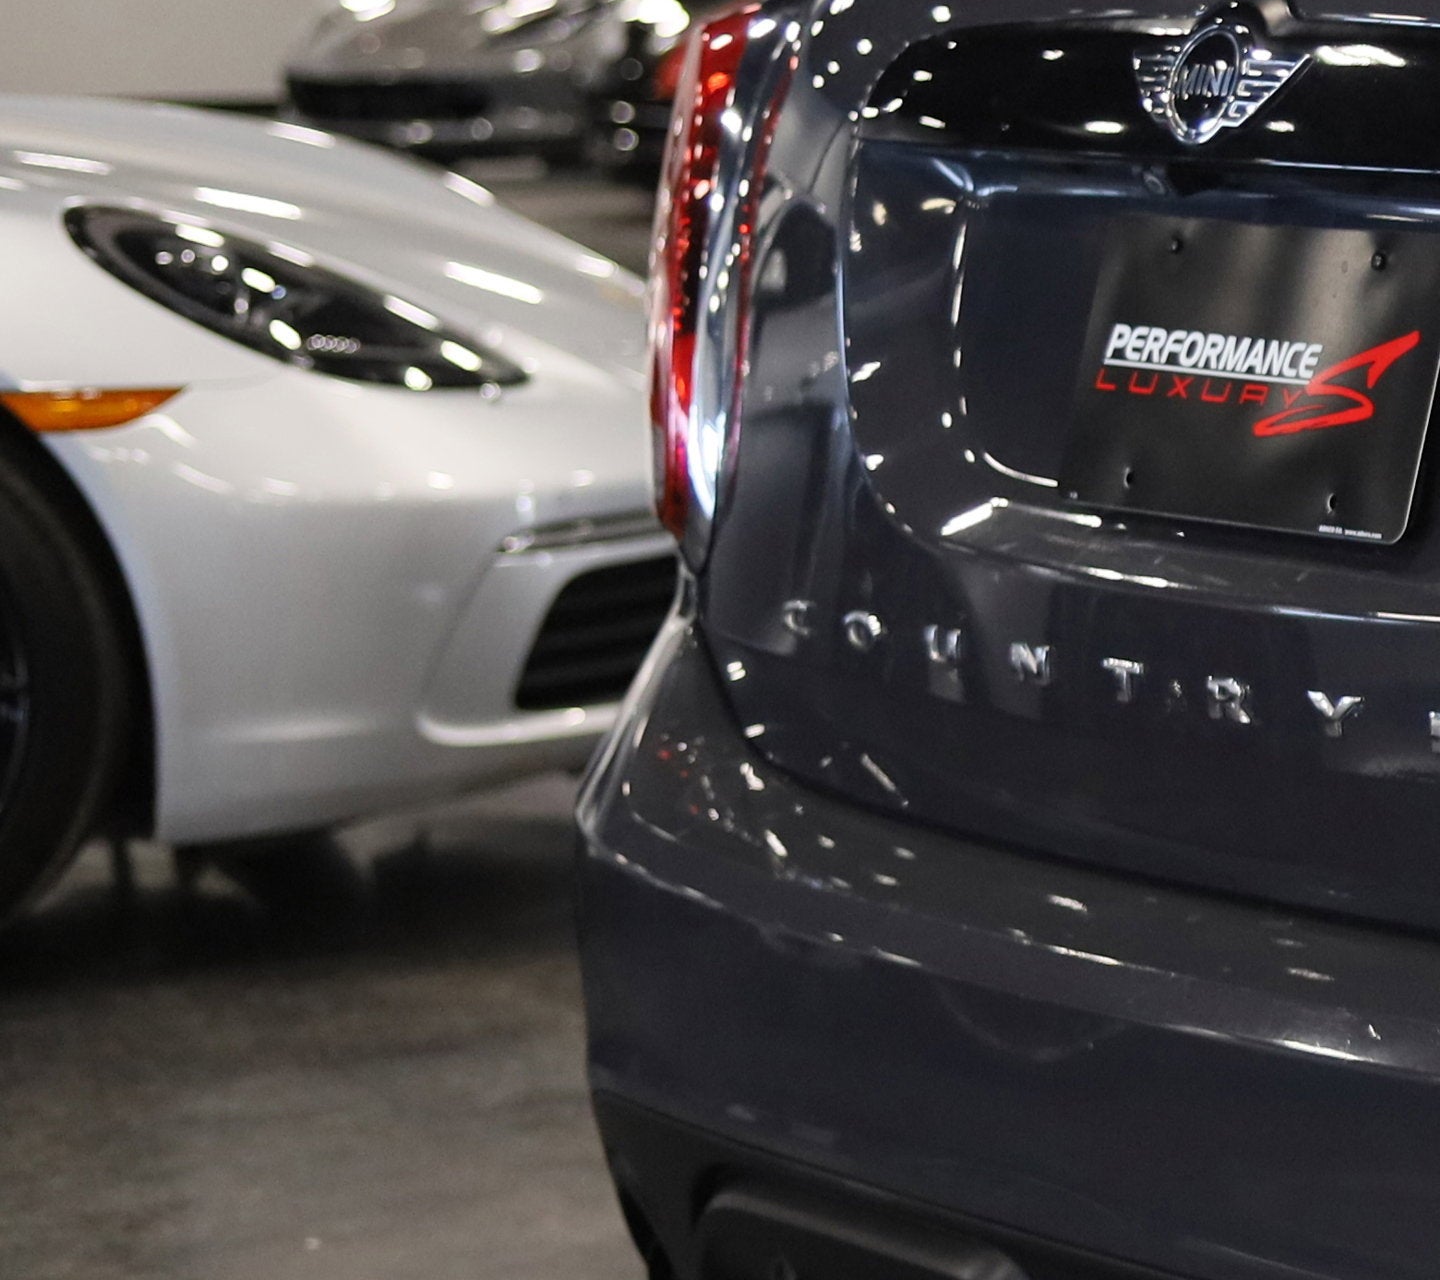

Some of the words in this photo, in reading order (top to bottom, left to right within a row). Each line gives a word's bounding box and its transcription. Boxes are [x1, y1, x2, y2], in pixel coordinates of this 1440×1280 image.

[1173, 63, 1236, 98] MINI
[1105, 322, 1323, 379] PERFORMANCE
[1094, 367, 1307, 408] LUXURY
